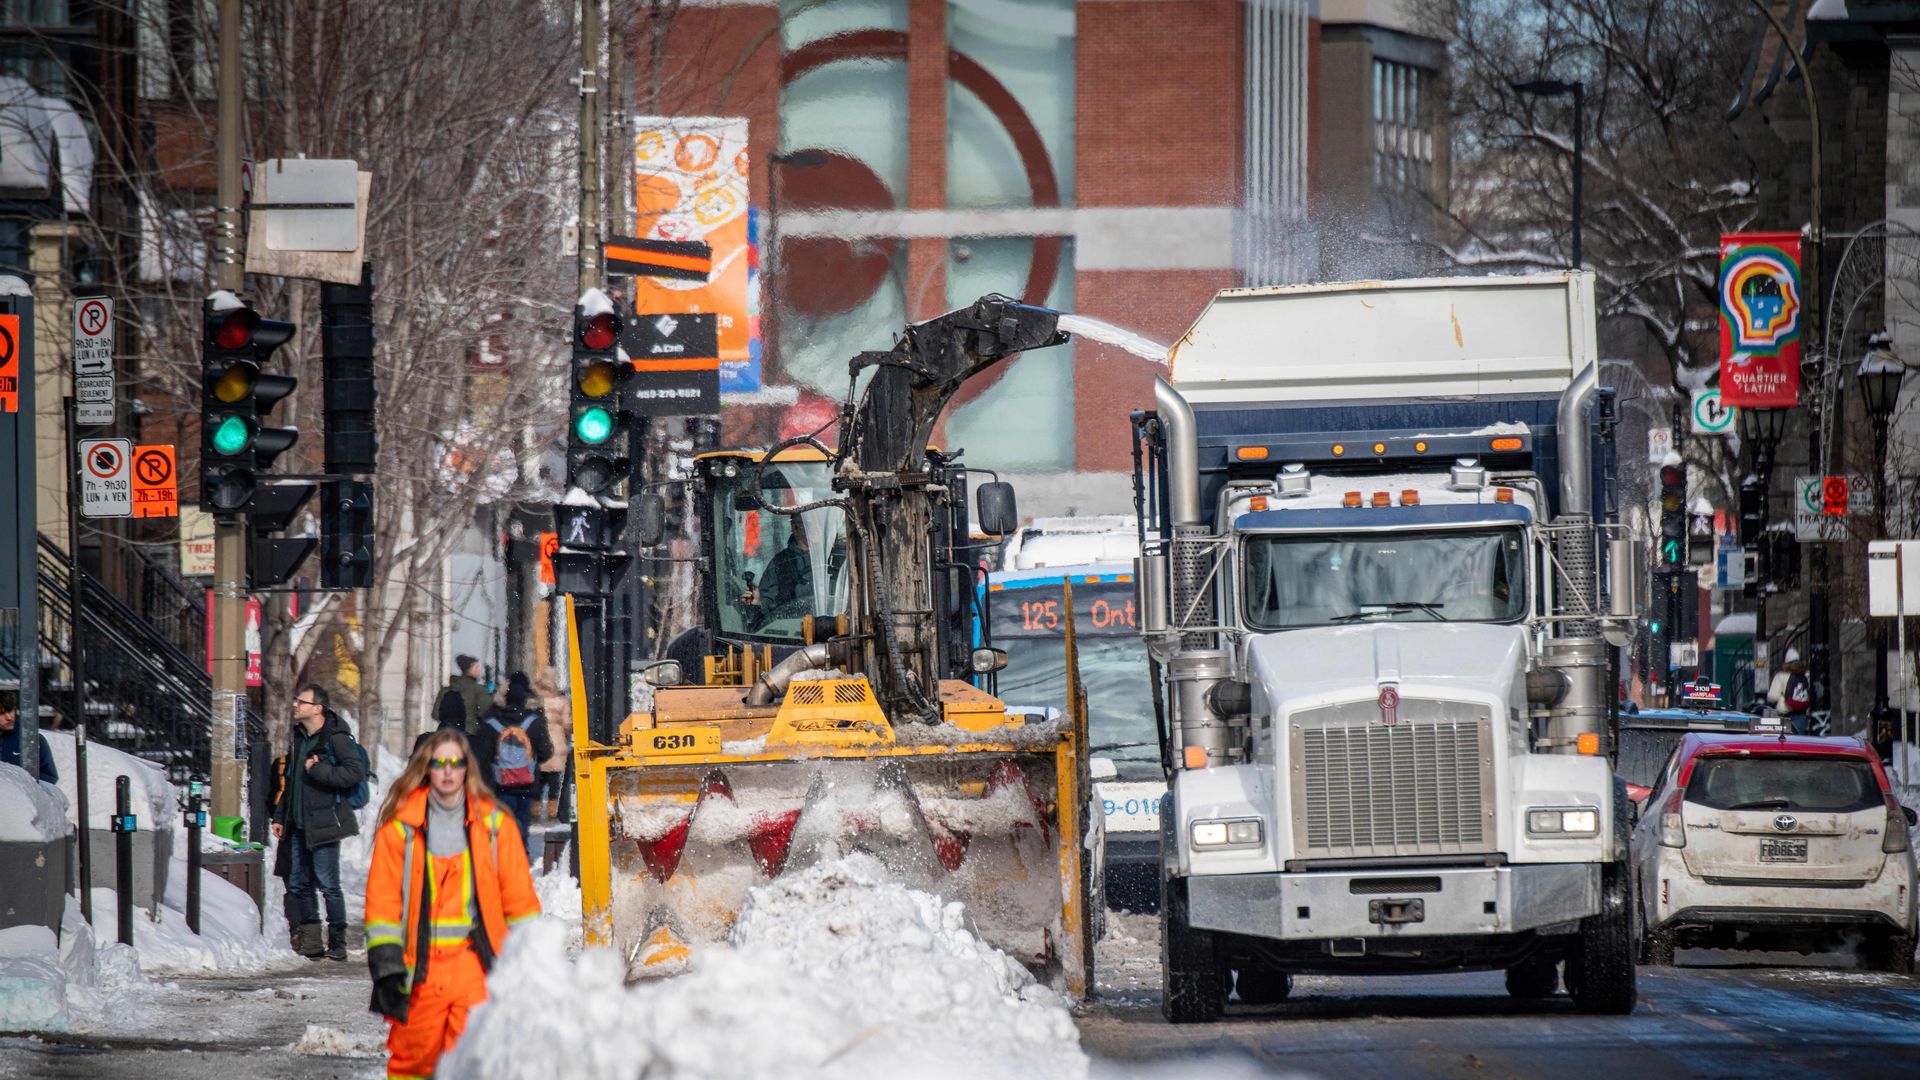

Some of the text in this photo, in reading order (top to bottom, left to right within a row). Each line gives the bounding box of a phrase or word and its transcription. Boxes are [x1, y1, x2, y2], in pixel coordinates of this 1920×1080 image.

[76, 338, 93, 348] 9h30
[100, 338, 111, 348] 16h
[78, 350, 90, 360] LUN
[97, 349, 109, 358] VEN
[1733, 373, 1787, 385] QUARTIER
[1744, 383, 1776, 393] LATIN
[80, 390, 109, 398] SEULEMENT
[85, 481, 96, 491] 7h
[104, 480, 127, 490] 9h30
[86, 493, 100, 503] LUN
[112, 492, 127, 502] VEN
[137, 490, 148, 501] 7h
[157, 490, 173, 500] 19h
[1022, 601, 1058, 630] 125
